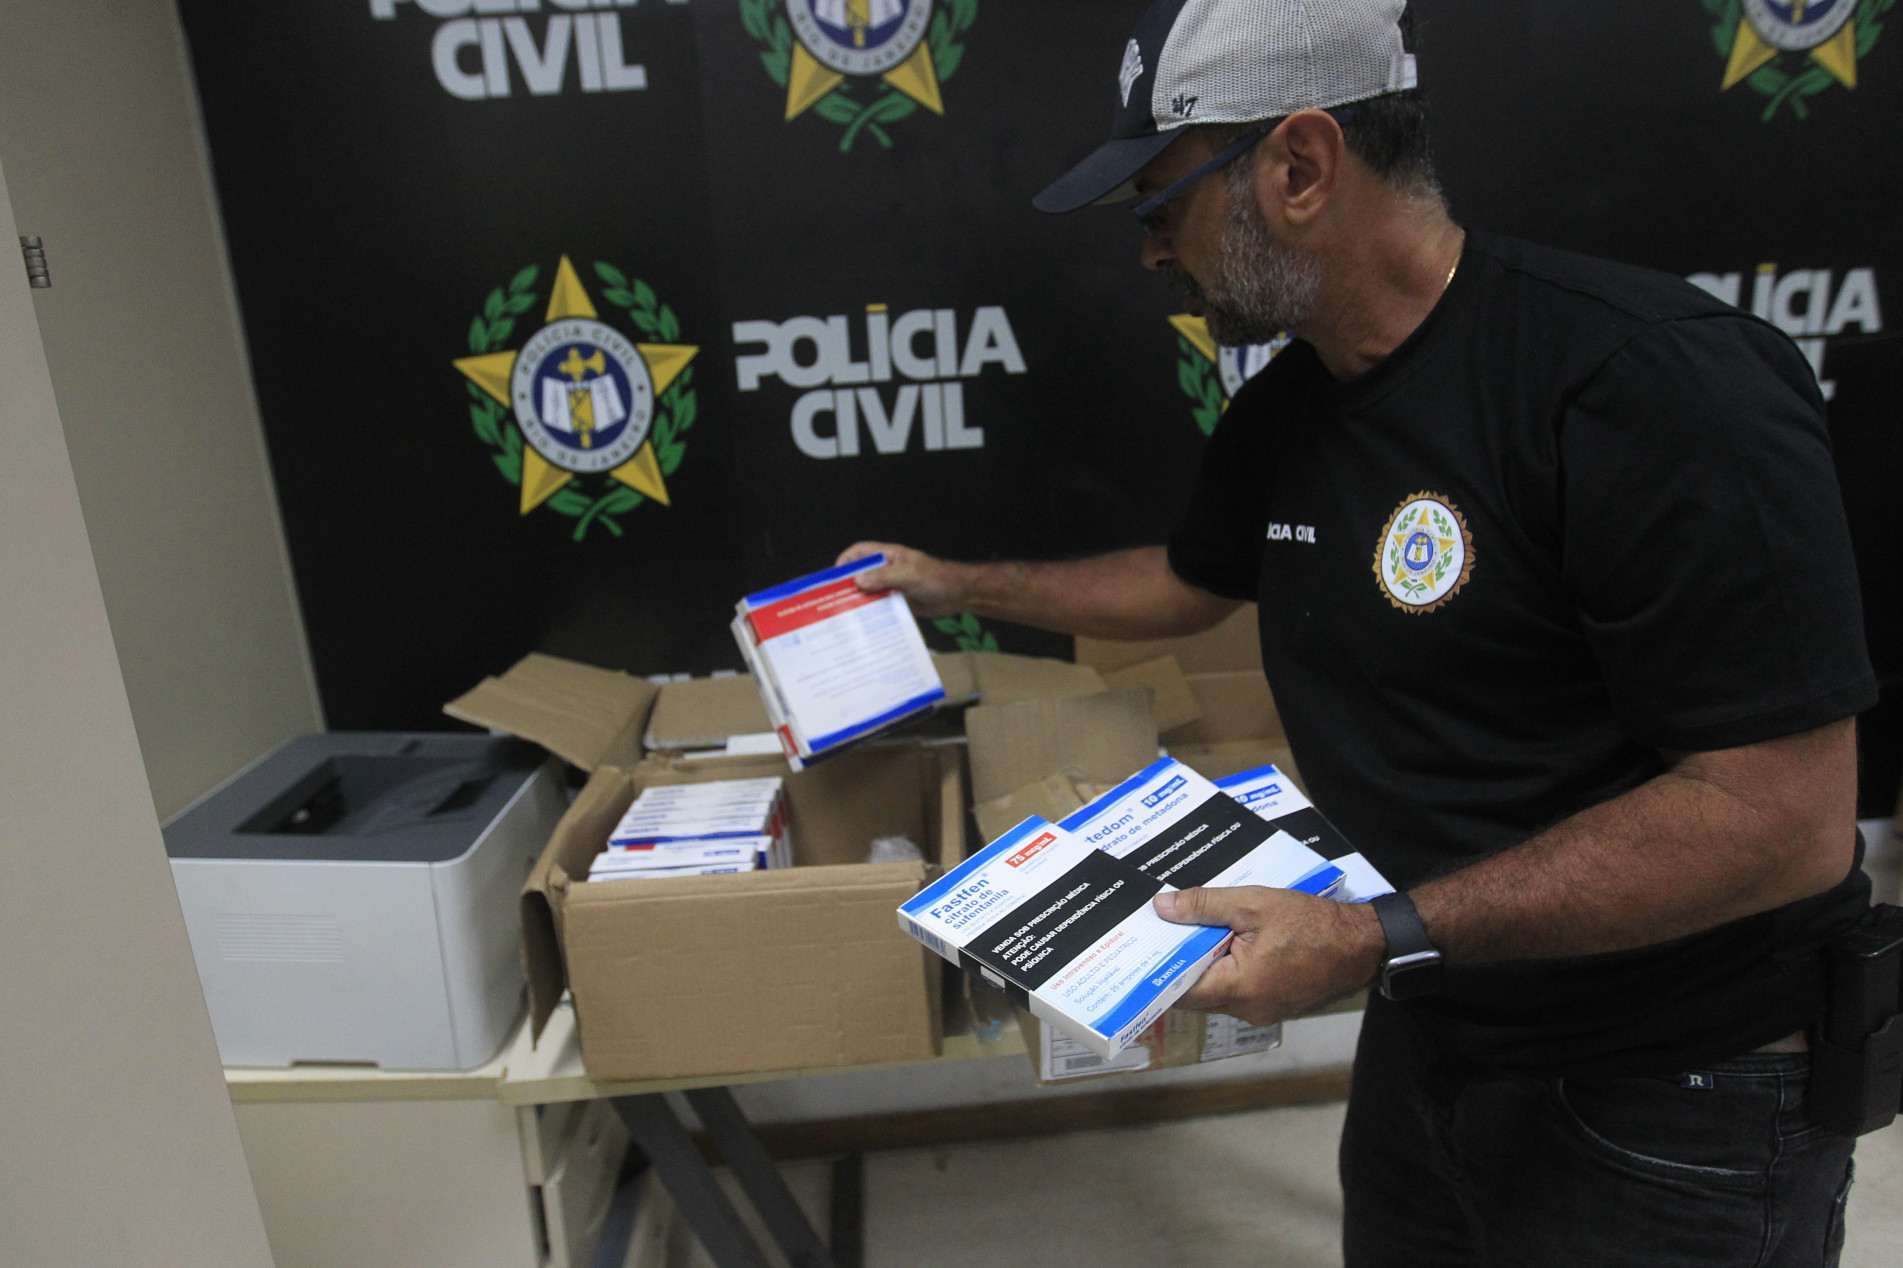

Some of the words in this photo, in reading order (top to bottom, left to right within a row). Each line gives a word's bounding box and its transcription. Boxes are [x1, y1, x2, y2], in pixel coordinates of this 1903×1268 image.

[431, 11, 648, 100] CIVIL
[733, 304, 1027, 391] POLÍCIA
[790, 382, 983, 459] CIVIL
[1086, 811, 1135, 844] tedom
[1101, 833, 1128, 852] drato
[1128, 823, 1143, 836] de
[1142, 792, 1189, 826] metadona
[930, 877, 991, 920] Fastfen
[944, 898, 979, 926] citrato
[979, 888, 994, 901] de
[953, 888, 1010, 931] sufentanila
[992, 936, 1017, 954] VENDA
[1014, 925, 1031, 938] SOB
[1027, 898, 1068, 928] PRESCRIÇÃO
[1065, 882, 1092, 901] MÉDICA
[1011, 950, 1033, 967] PODE
[1029, 931, 1058, 952] CAUSAR
[1054, 901, 1098, 933] DEPENDÊNCIA
[1094, 887, 1117, 903] FÍSICA
[1112, 879, 1125, 890] OU
[1002, 934, 1036, 961] ATENÇÃO:
[1020, 946, 1055, 972] PSÍQUICA
